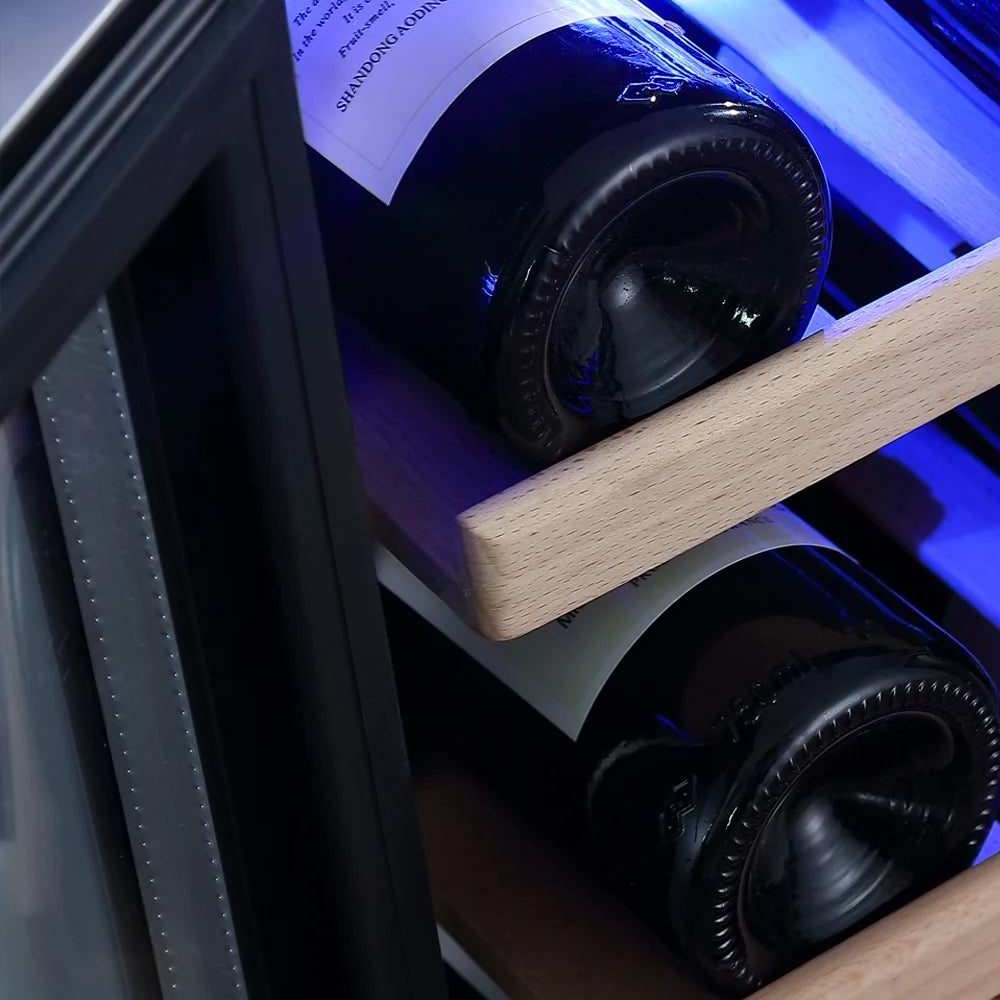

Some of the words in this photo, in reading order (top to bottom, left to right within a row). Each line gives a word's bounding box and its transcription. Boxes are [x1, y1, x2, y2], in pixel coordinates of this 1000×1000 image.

[292, 5, 313, 28] The
[342, 12, 355, 25] It
[352, 2, 365, 14] is
[291, 48, 304, 62] In
[302, 28, 318, 48] the
[335, 33, 399, 113] SHANDONG
